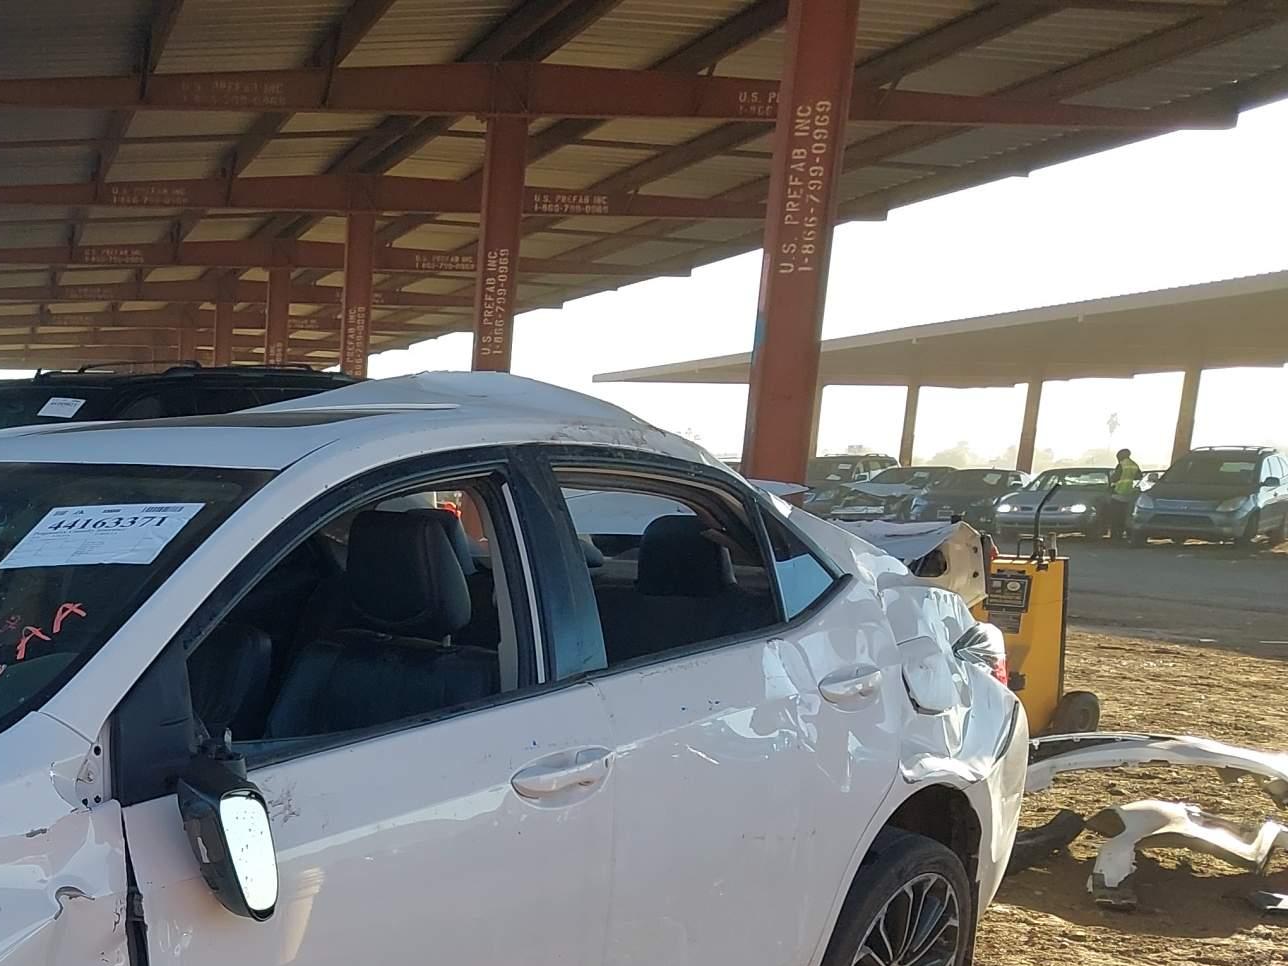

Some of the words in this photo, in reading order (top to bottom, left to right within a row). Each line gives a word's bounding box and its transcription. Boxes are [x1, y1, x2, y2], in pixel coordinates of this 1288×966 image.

[739, 91, 761, 104] U.S.
[785, 148, 807, 225] PREFAB
[798, 101, 831, 271] 1-866-799-0969
[778, 237, 798, 273] U.S.
[483, 277, 497, 325] PREFAB
[48, 516, 169, 531] 44163371
